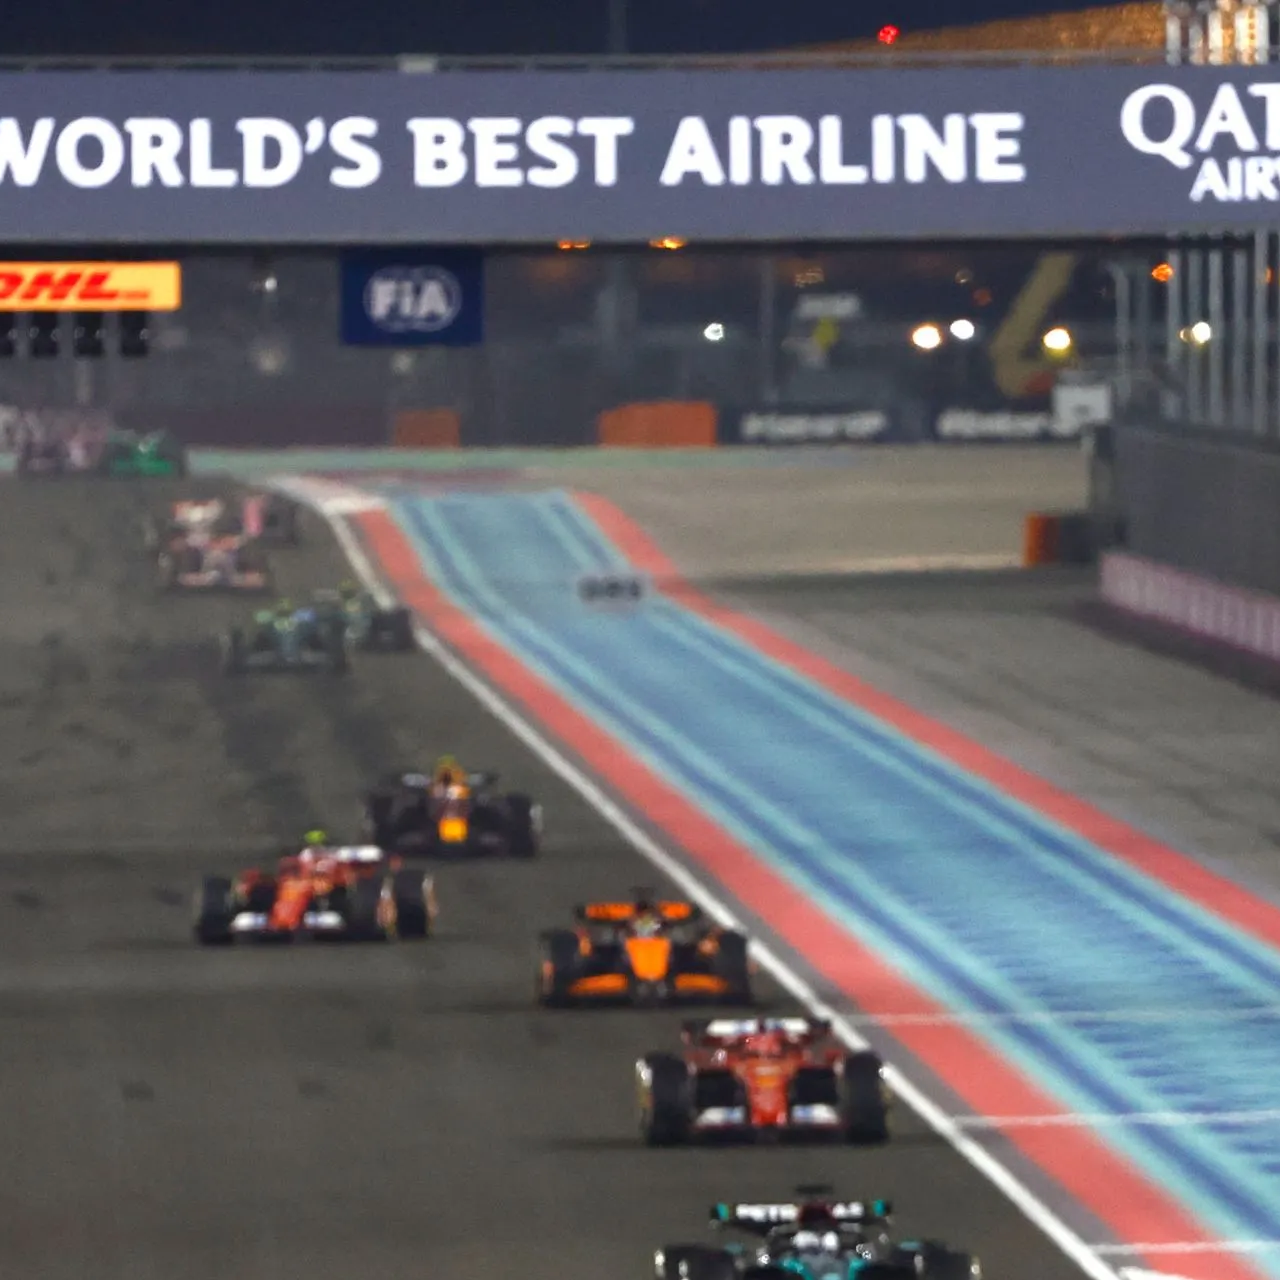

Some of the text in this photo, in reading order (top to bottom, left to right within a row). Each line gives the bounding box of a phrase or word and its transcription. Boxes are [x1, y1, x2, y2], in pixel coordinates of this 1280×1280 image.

[406, 116, 635, 188] BEST
[659, 111, 1026, 186] AIRLINE
[370, 278, 448, 318] FIA
